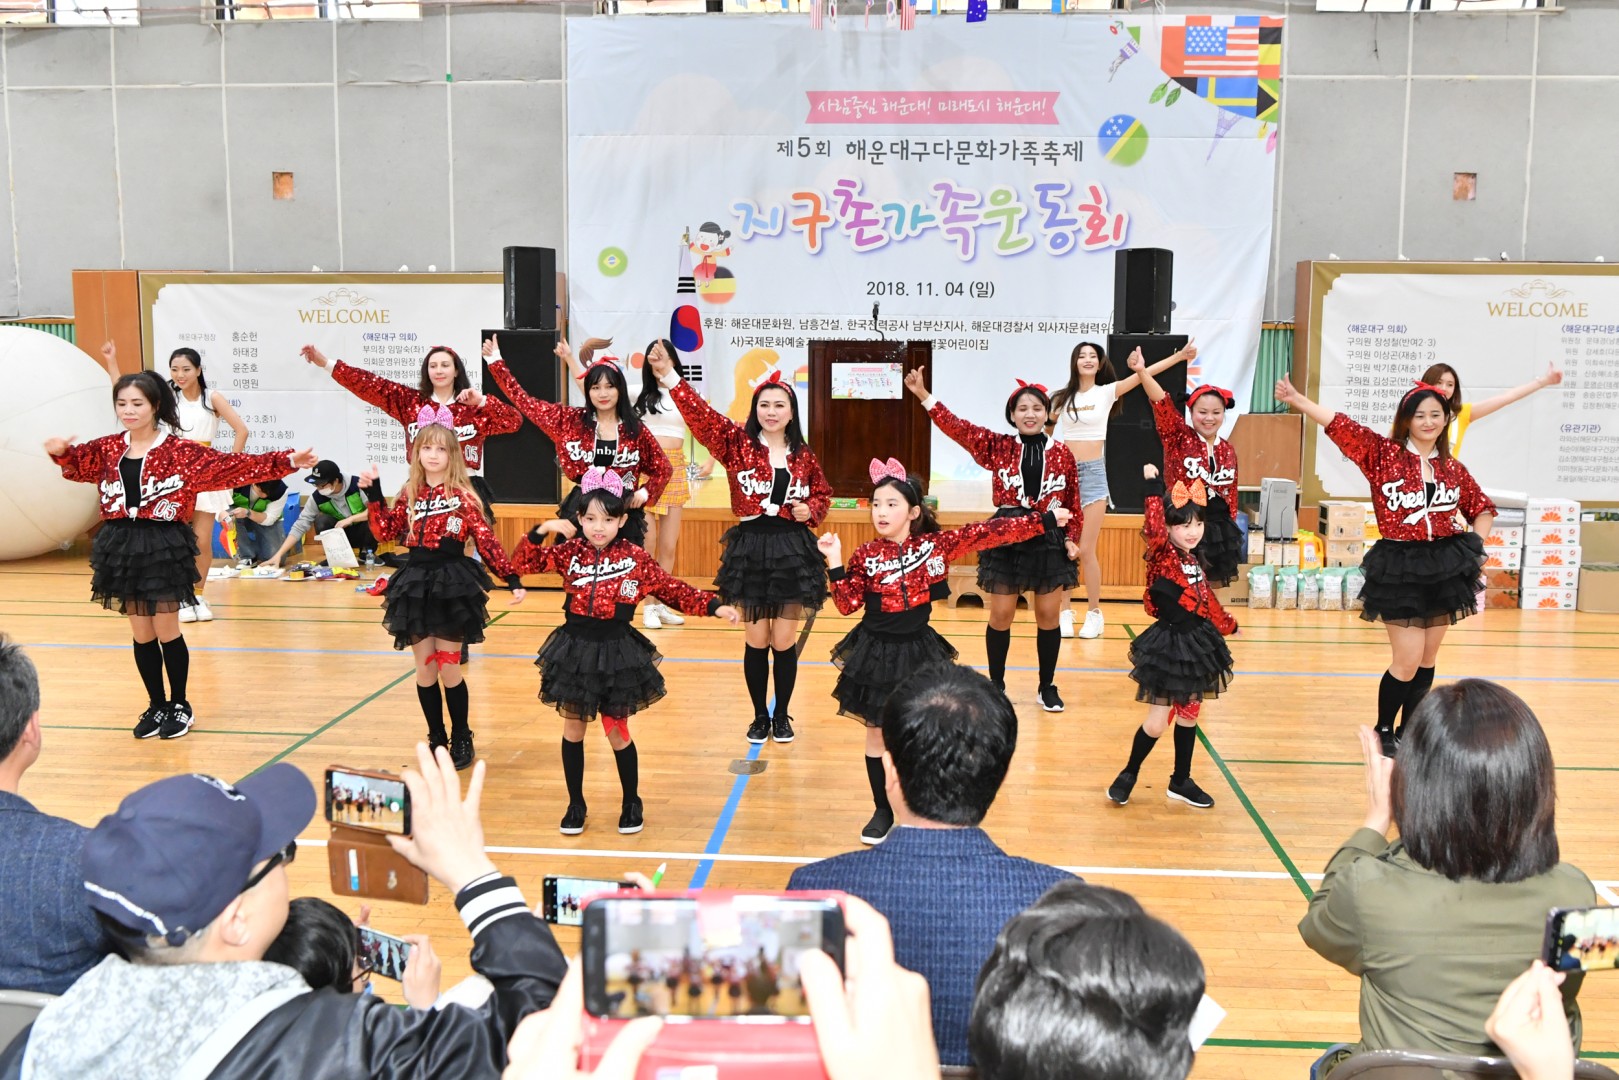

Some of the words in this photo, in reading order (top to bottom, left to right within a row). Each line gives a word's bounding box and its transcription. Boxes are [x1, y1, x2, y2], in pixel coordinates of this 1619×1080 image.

[818, 98, 878, 119] 사람중심
[882, 97, 931, 117] 해운대!
[938, 98, 990, 114] 미래도시
[996, 97, 1047, 117] 해운대!
[846, 139, 1084, 166] 해운대구다문화가족축제
[731, 177, 1127, 259] 지구촌가족운동회
[866, 281, 910, 297] 2018.
[916, 281, 939, 297] 11.
[944, 281, 965, 297] 04
[969, 281, 996, 299] (일)
[298, 309, 390, 324] WELCOME
[1486, 302, 1589, 318] WELCOME
[703, 317, 727, 329] 후원:
[731, 317, 795, 330] 해운대문화원,
[799, 318, 843, 331] 남흥건설,
[912, 320, 967, 333] 남부산지사,
[971, 320, 1034, 333] 해운대경찰서
[1037, 321, 1113, 334] 외사자문협력위
[232, 331, 258, 342] 홍순헌
[1346, 337, 1372, 346] 구의원
[232, 347, 258, 358] 하태경
[1346, 350, 1371, 359] 구의원
[1346, 363, 1371, 372] 구의원
[1345, 376, 1370, 386] 구의원
[1345, 389, 1370, 398] 구의원
[1344, 402, 1369, 410] 구의원
[365, 430, 388, 439] 구의원
[366, 443, 388, 451] 구의원
[464, 444, 479, 463] 05
[366, 455, 388, 463] 구의원
[153, 498, 182, 522] 05
[926, 555, 945, 577] 05
[620, 579, 639, 598] 05
